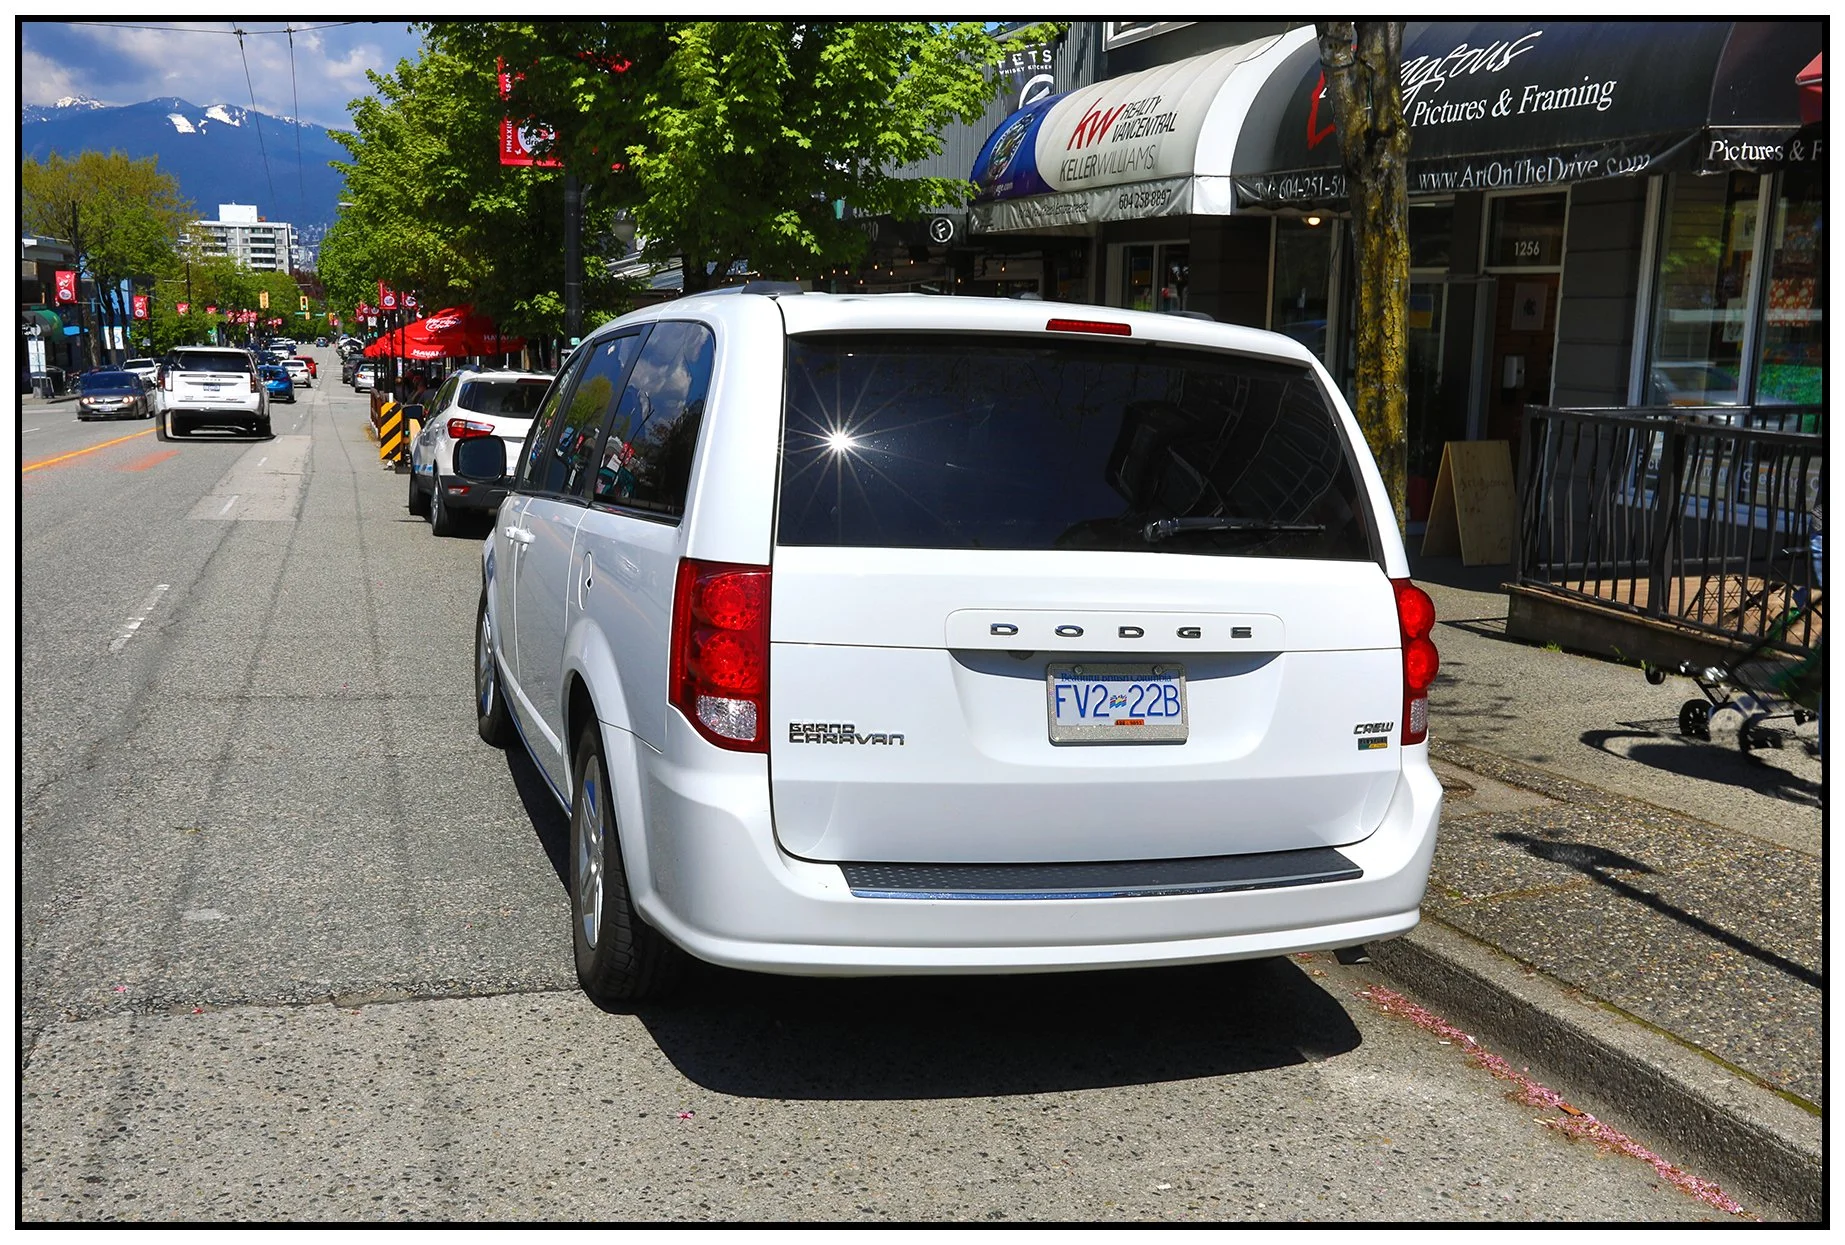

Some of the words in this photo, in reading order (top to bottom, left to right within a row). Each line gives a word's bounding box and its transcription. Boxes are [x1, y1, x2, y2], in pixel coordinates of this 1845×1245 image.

[1119, 95, 1162, 121] REALTY
[1411, 98, 1487, 127] Pictures
[1491, 88, 1513, 117] &
[1517, 75, 1617, 112] Framing
[1111, 111, 1178, 143] VANCENTRAL
[1708, 139, 1784, 161] Pictures
[1789, 139, 1805, 161] &
[1514, 241, 1540, 256] 1256
[990, 623, 1253, 639] DODGE
[789, 722, 855, 734] GRAND
[1353, 721, 1394, 735] CREW
[789, 732, 905, 746] CARAVAN
